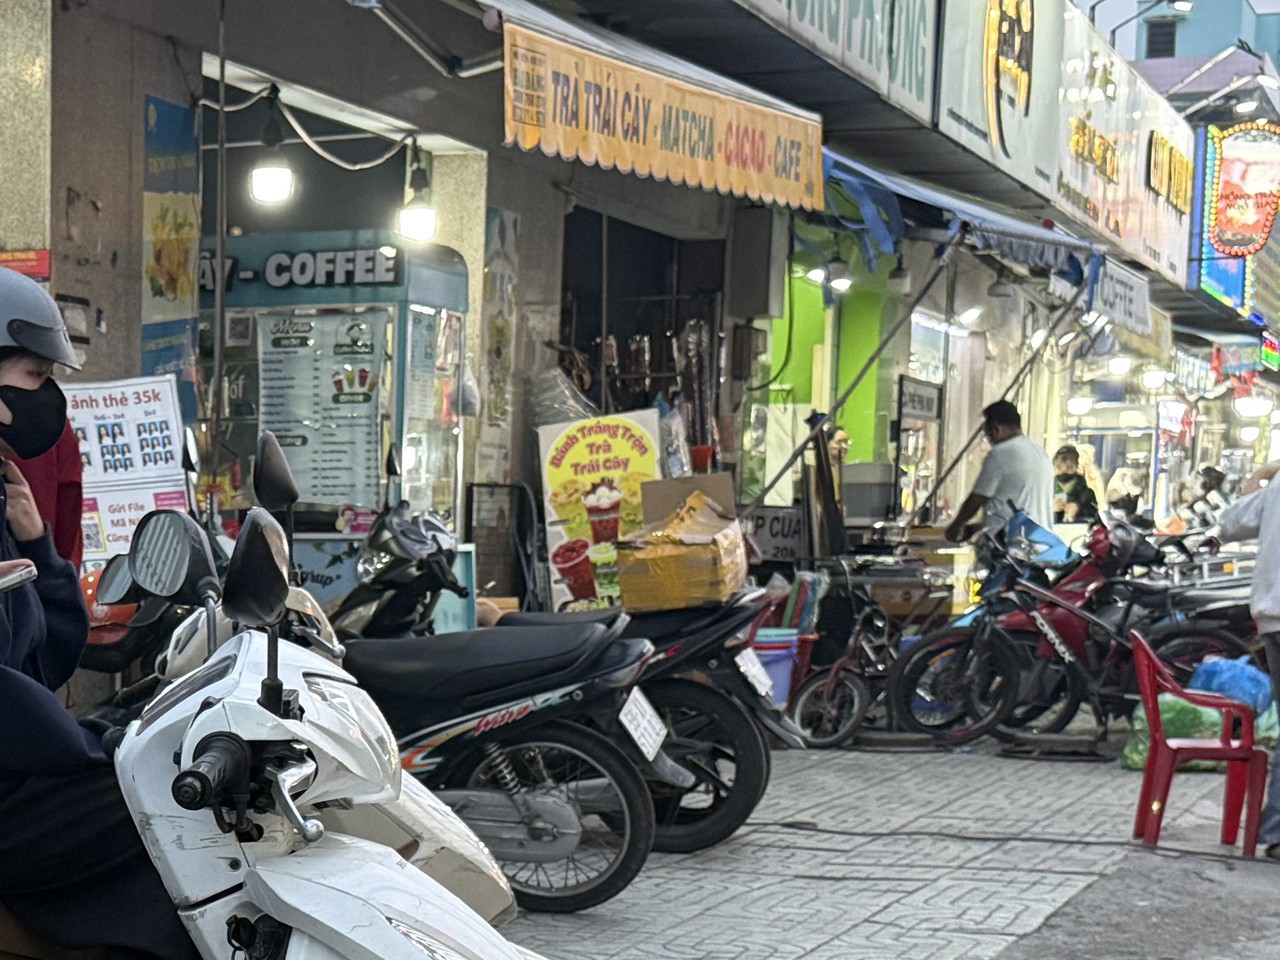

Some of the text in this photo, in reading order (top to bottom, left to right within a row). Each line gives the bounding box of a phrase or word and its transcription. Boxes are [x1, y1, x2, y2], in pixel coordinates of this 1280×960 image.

[552, 62, 580, 130] TRÀ
[584, 72, 618, 138] TRÁI
[661, 103, 714, 162] MATCHA
[724, 121, 766, 174] CACAO
[774, 135, 802, 183] CAFE
[265, 247, 397, 288] COFFEE
[70, 388, 162, 410] ảnh thẻ 35k
[577, 420, 621, 440] Tráng
[586, 439, 612, 456] Trà
